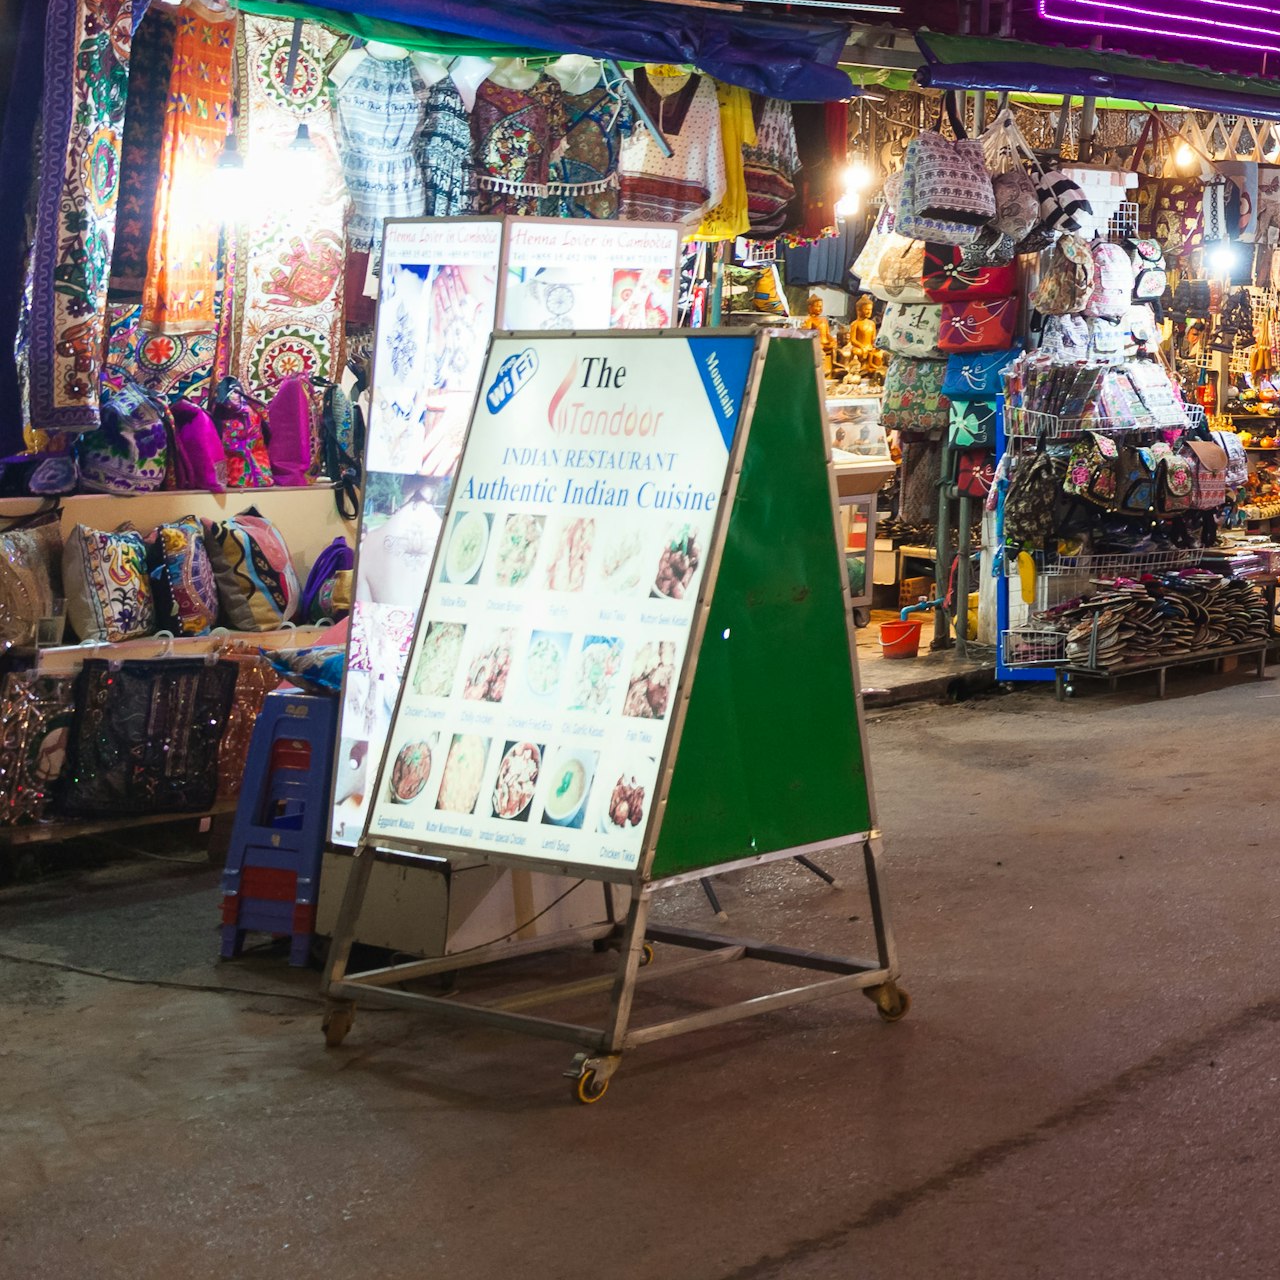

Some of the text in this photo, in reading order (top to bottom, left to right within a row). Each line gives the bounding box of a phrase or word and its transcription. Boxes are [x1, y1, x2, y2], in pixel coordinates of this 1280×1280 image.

[386, 228, 416, 243] Henna
[510, 228, 673, 249] Henna Lover in Cambodia
[581, 356, 626, 389] The
[705, 351, 735, 419] Mountain
[569, 401, 664, 437] Tandoor
[502, 446, 678, 472] INDIAN RESTAURANT
[459, 475, 717, 512] Authentic Indian Cuisine
[600, 845, 620, 860] Chicken
